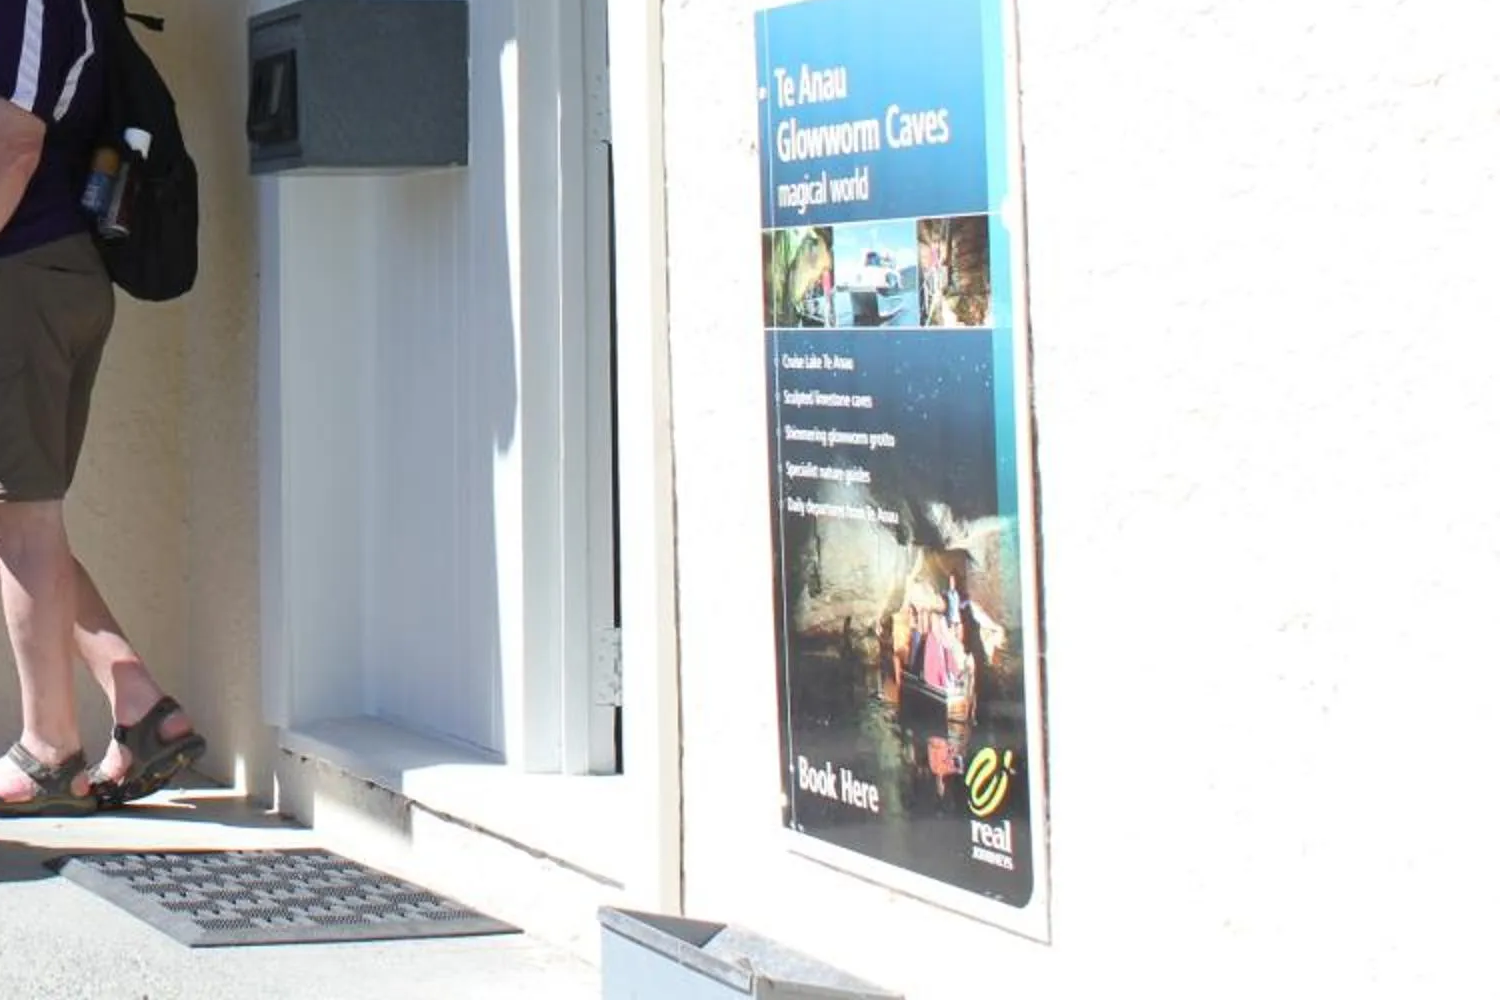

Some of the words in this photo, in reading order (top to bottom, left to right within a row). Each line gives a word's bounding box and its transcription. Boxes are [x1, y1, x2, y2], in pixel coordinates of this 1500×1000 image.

[774, 67, 795, 109] Te
[799, 63, 847, 105] Anau
[777, 116, 881, 163] Glowworm
[885, 103, 950, 149] Caves
[777, 169, 827, 214] magical
[830, 166, 870, 203] world
[798, 755, 838, 800] Book
[840, 767, 880, 814] Here
[971, 819, 1013, 854] real
